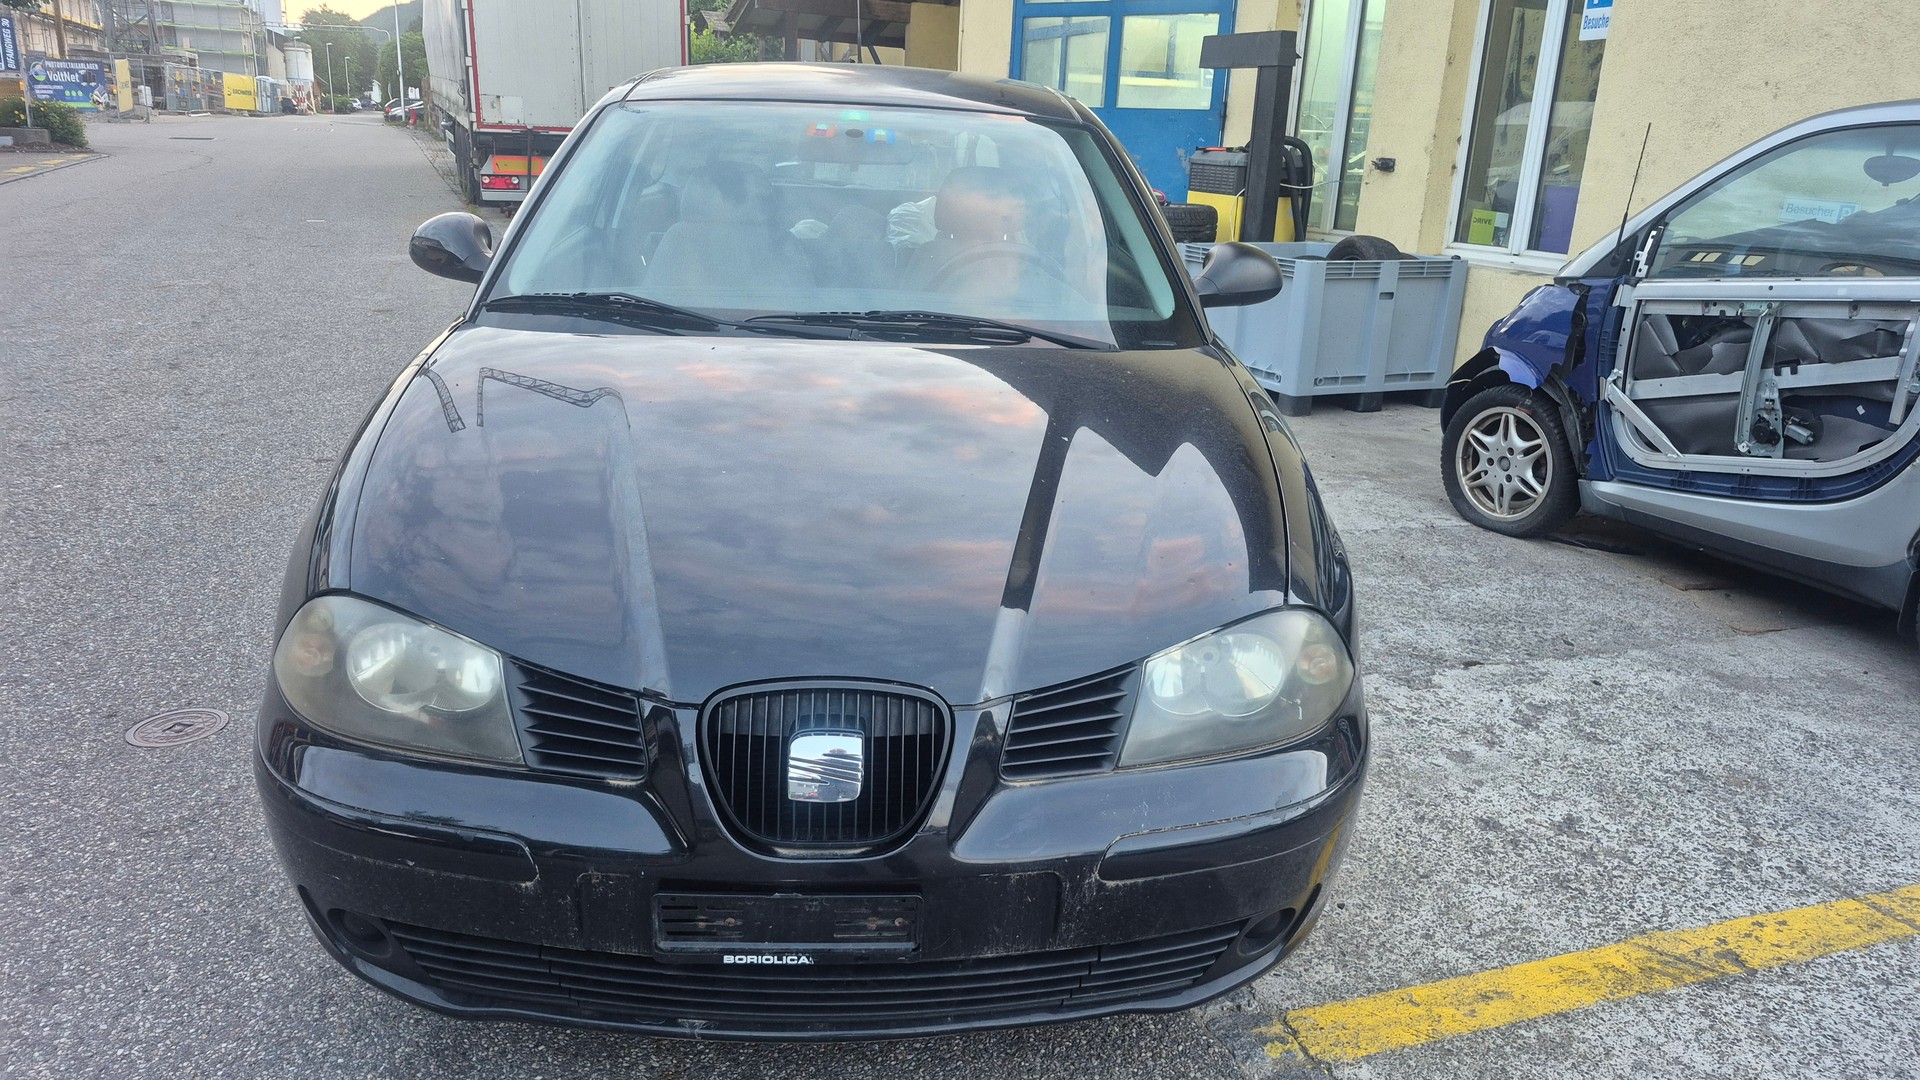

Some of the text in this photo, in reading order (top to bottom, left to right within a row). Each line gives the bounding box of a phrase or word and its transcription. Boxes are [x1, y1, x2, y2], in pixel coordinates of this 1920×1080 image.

[1, 17, 16, 69] BIFANGWEG 30
[46, 70, 80, 83] VoltNet
[1785, 203, 1836, 218] Besucher
